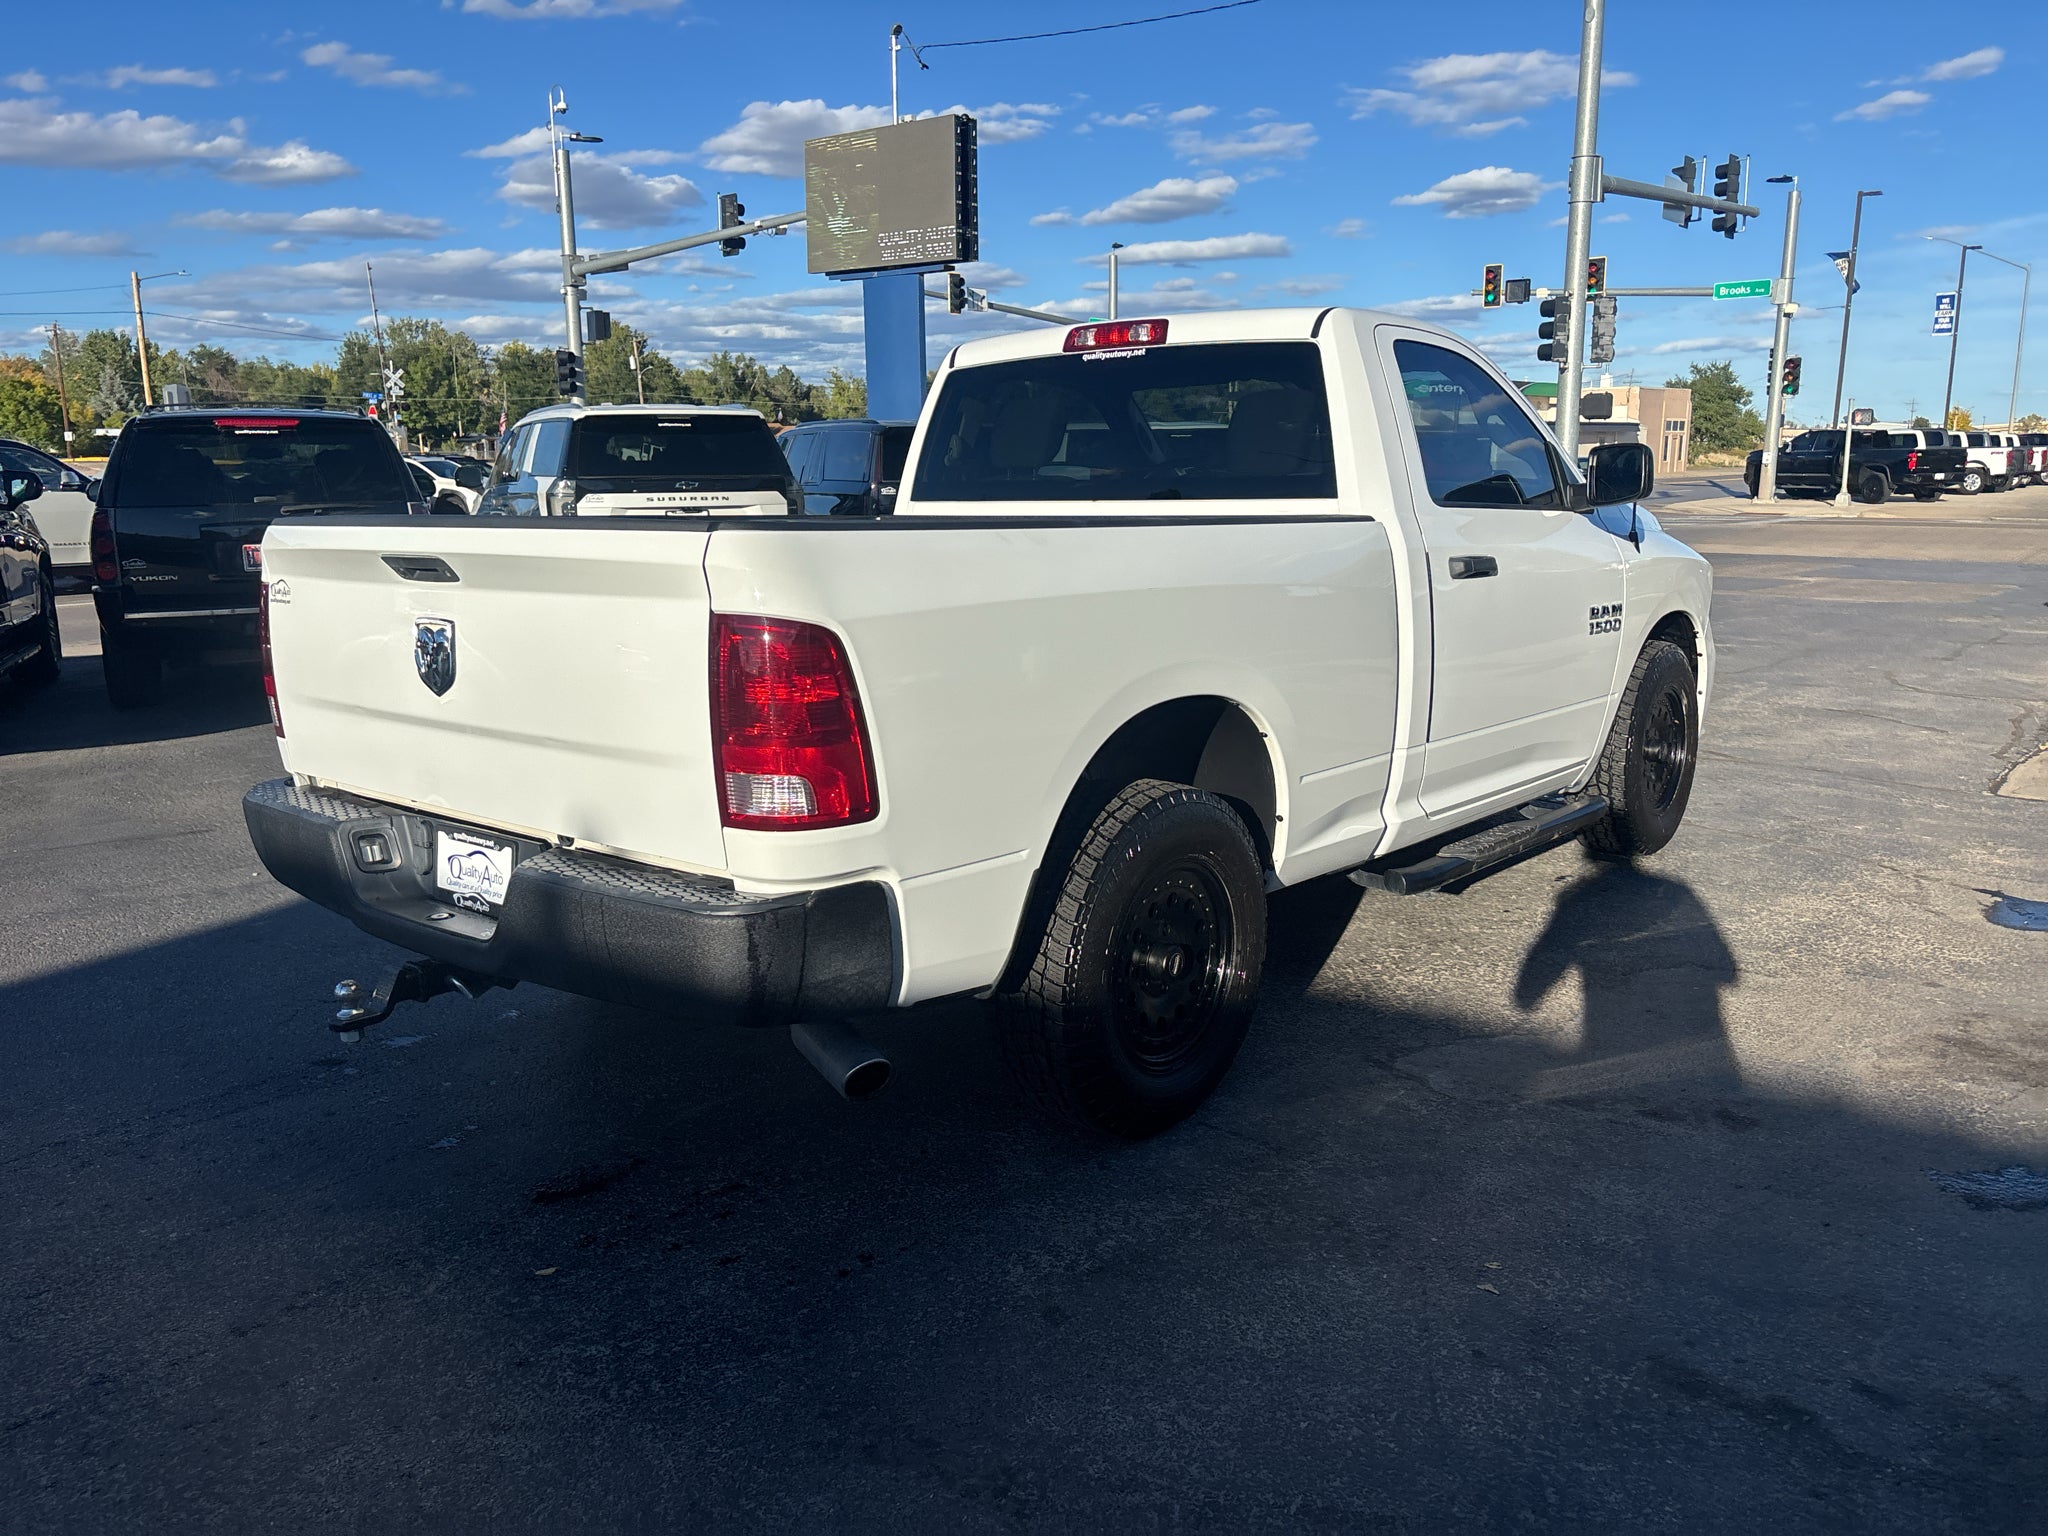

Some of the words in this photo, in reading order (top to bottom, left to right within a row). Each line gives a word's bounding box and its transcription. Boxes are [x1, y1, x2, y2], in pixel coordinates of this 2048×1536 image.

[878, 229, 923, 246] QUALITY
[926, 225, 956, 240] AUTO
[1719, 286, 1751, 296] Brooks
[1082, 348, 1146, 361] qualityautowy.net
[1589, 603, 1623, 620] RAM
[1589, 618, 1622, 635] 1500
[446, 877, 462, 888] Quality
[478, 885, 492, 897] Quality
[492, 891, 502, 899] price
